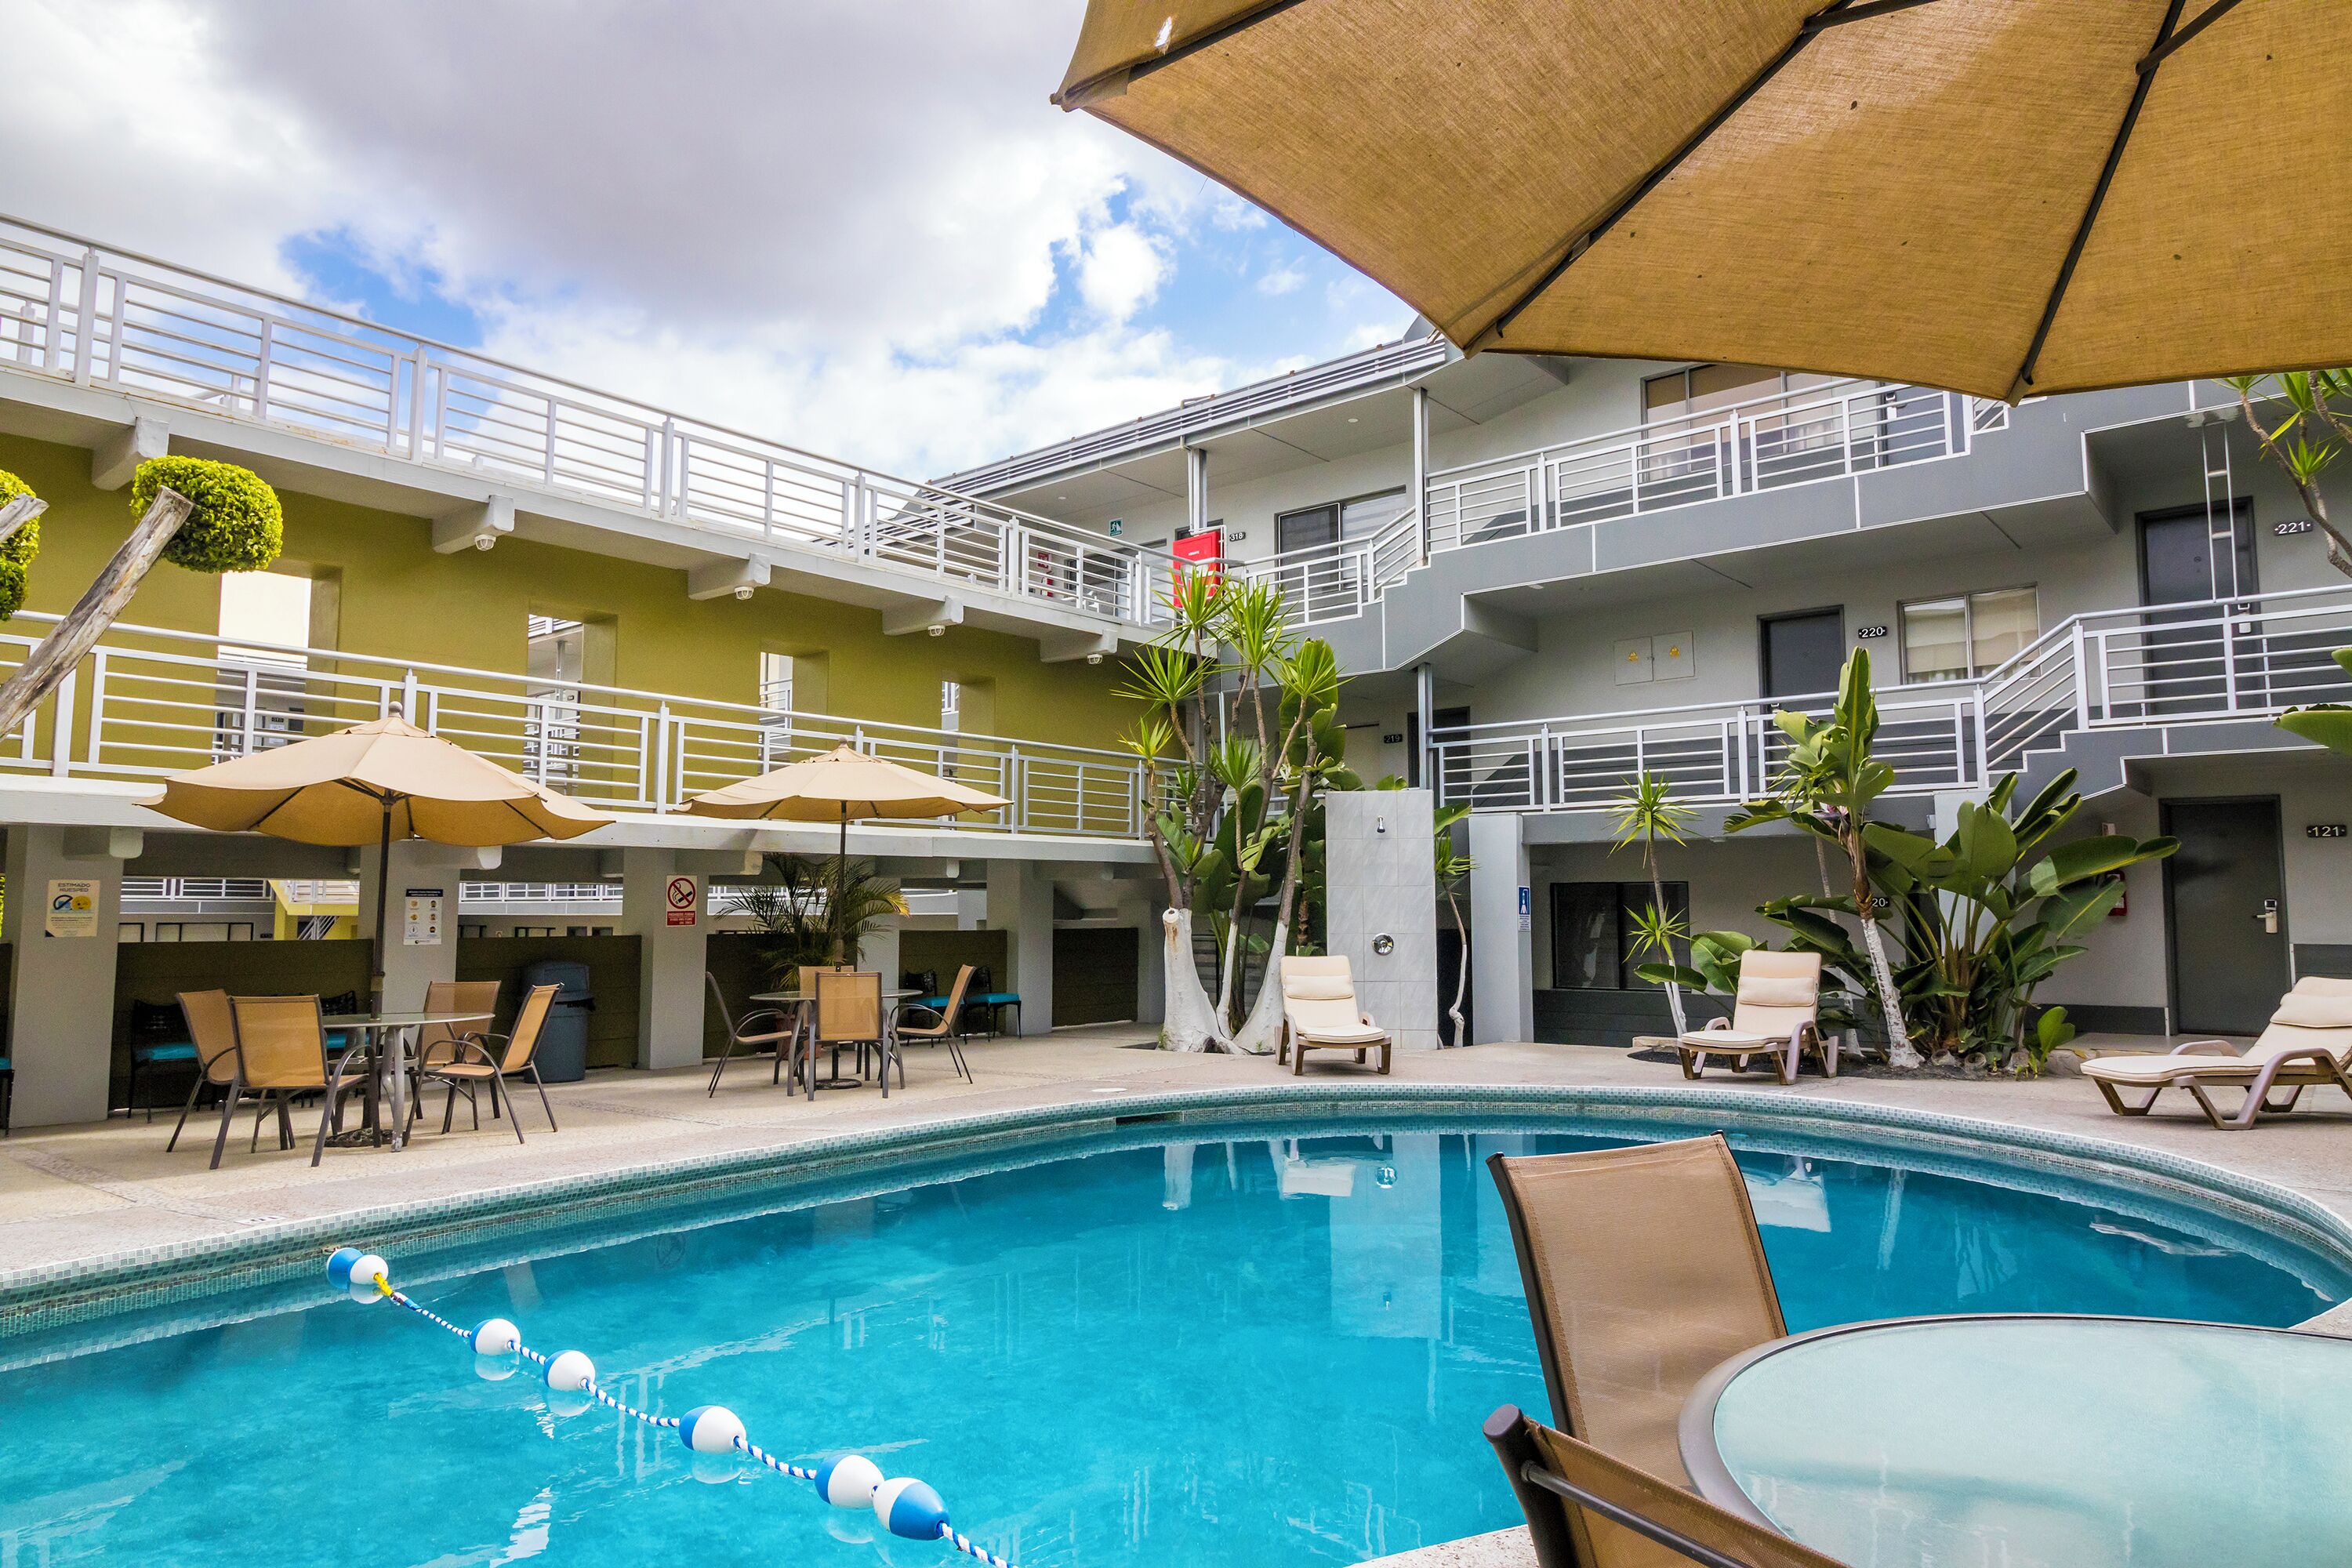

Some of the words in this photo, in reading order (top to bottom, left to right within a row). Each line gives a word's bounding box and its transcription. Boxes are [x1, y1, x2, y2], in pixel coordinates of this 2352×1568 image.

[2278, 521, 2304, 534] 221
[1231, 532, 1243, 541] 318
[1861, 626, 1883, 638] 220
[1385, 735, 1400, 743] 219
[2312, 826, 2339, 837] 121
